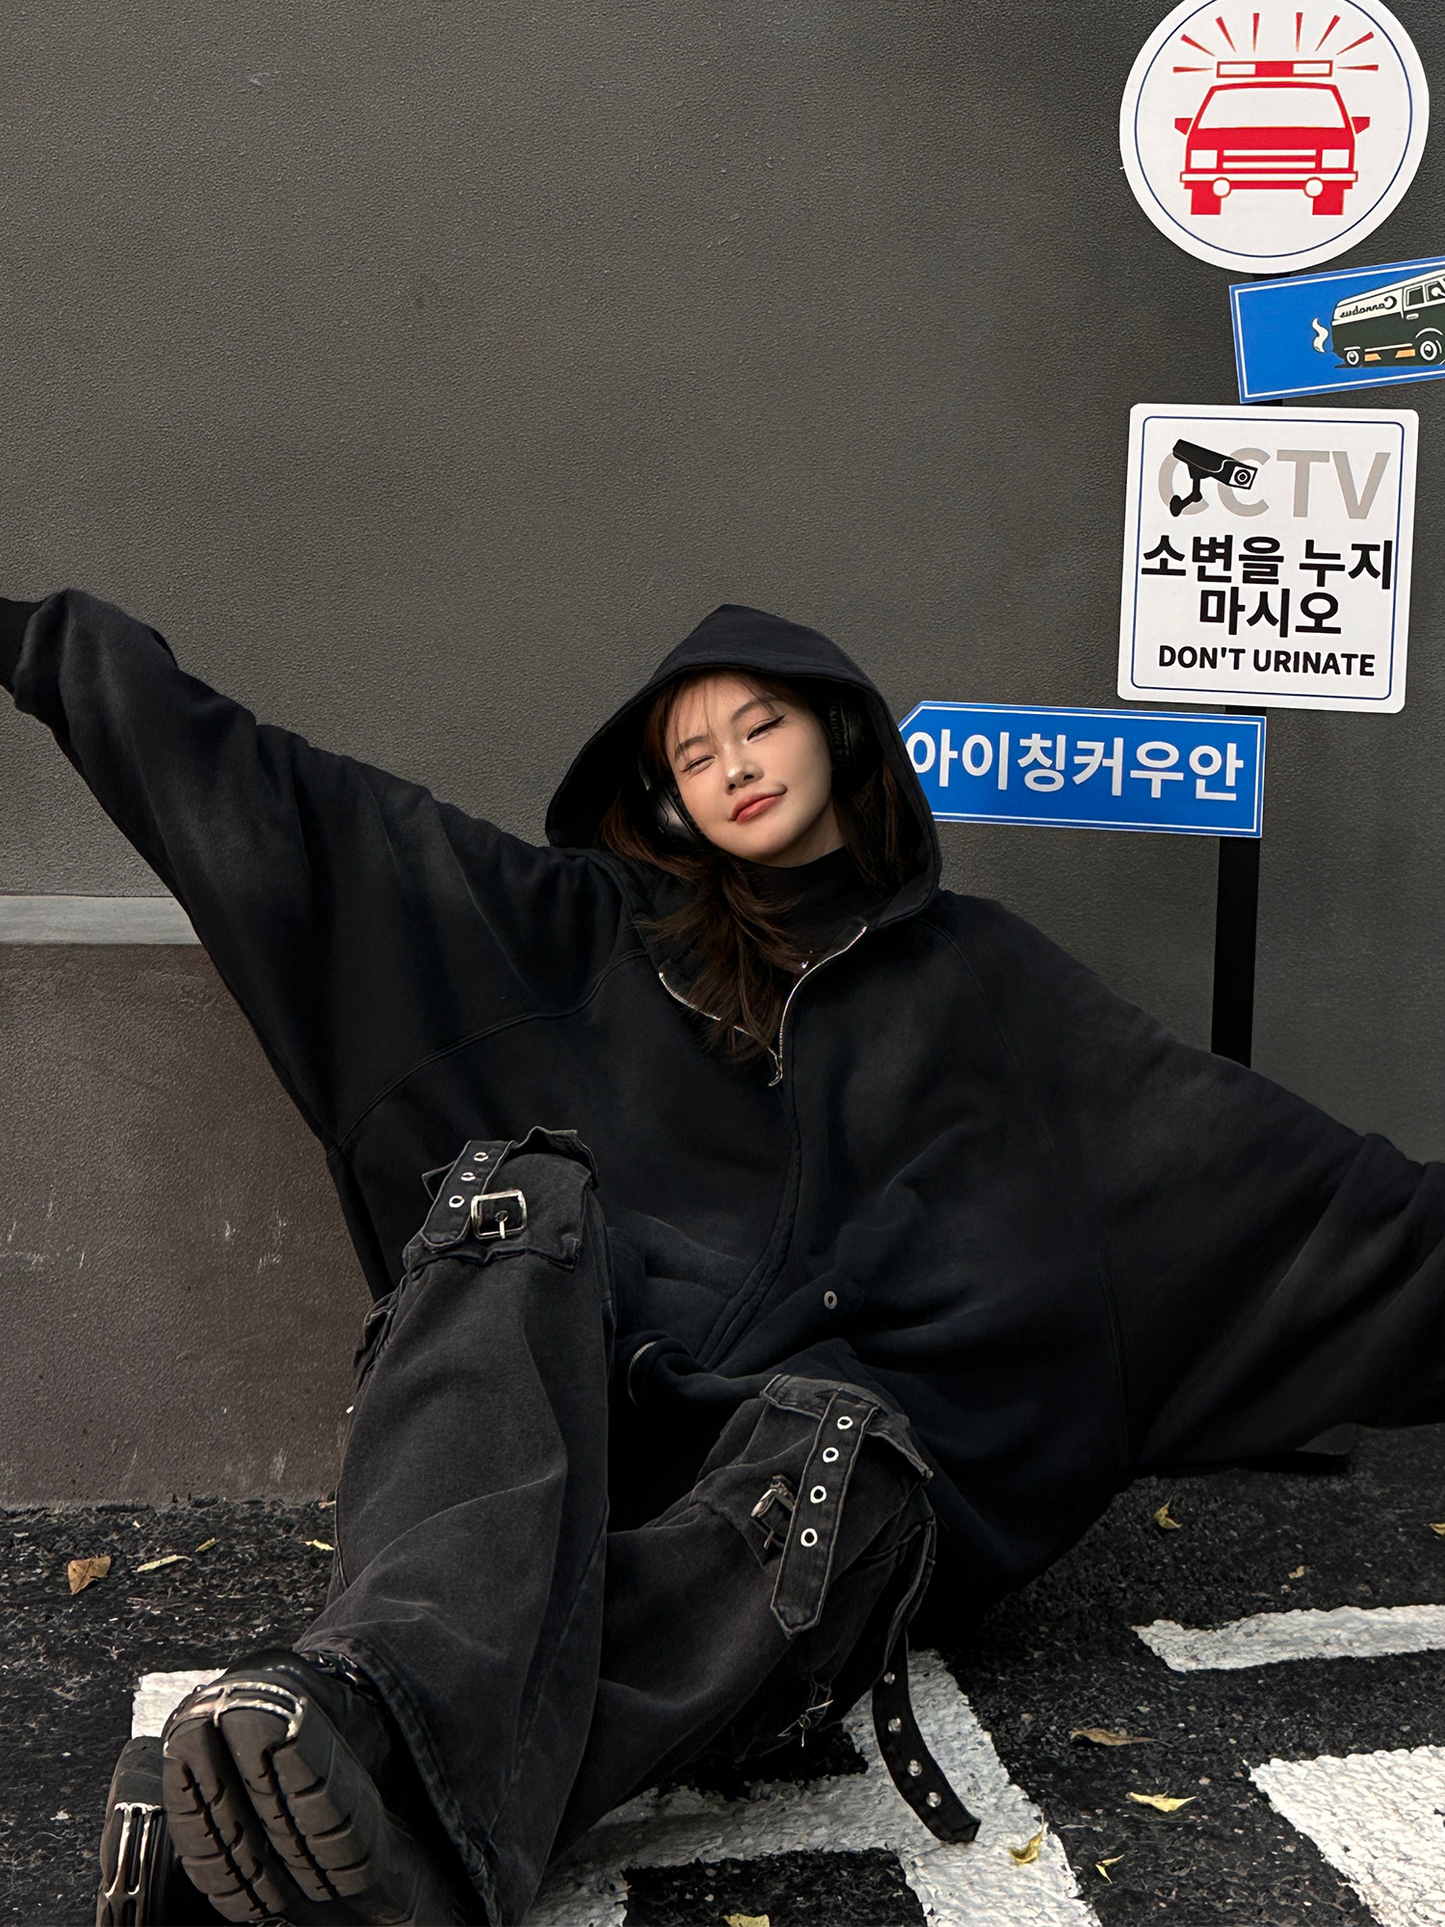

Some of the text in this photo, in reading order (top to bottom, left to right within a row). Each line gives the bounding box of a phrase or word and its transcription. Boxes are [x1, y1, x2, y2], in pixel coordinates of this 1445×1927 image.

[1141, 535, 1393, 590] 소변을 누지
[1200, 586, 1341, 637] 마시오
[1159, 646, 1375, 676] DON'T URINATE
[907, 728, 1244, 801] 아이칭커우안
